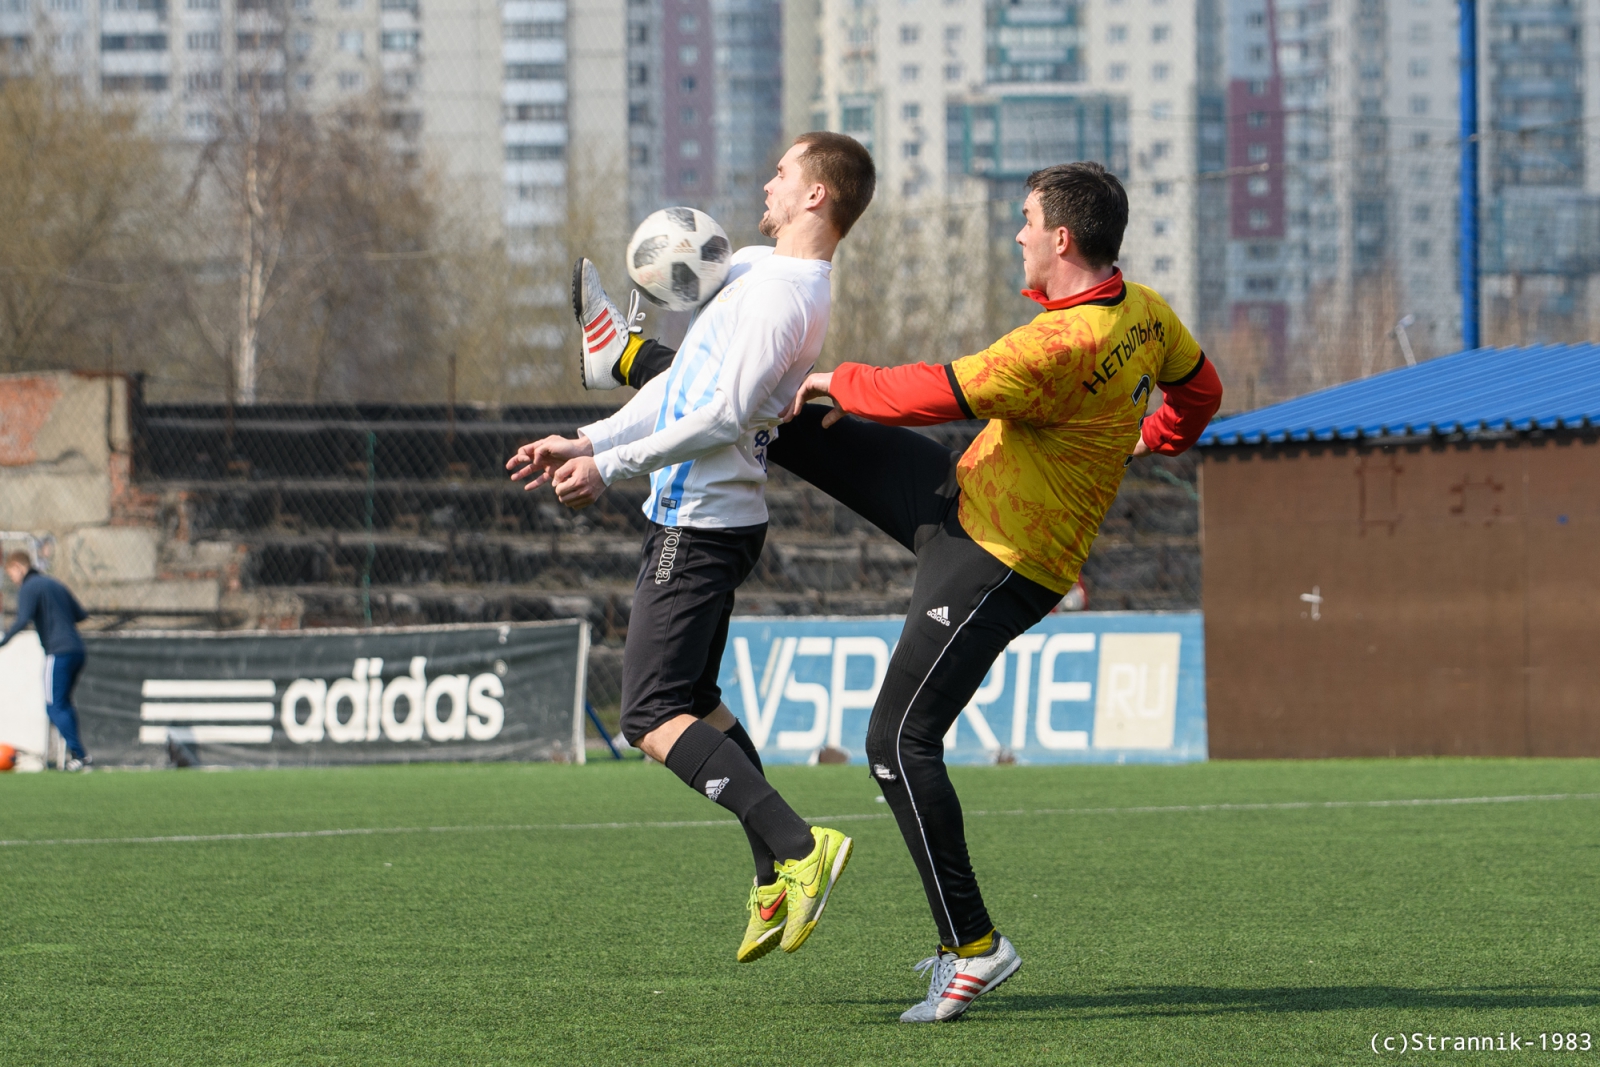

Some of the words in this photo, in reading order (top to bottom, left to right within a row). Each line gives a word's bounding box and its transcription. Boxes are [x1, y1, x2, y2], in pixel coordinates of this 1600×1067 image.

[1082, 318, 1165, 395] НЕТЫЛЬК
[926, 610, 951, 627] adidas
[280, 656, 505, 744] adidas
[733, 632, 1096, 750] VSPRTE
[1105, 662, 1167, 720] RU
[709, 776, 730, 803] didas
